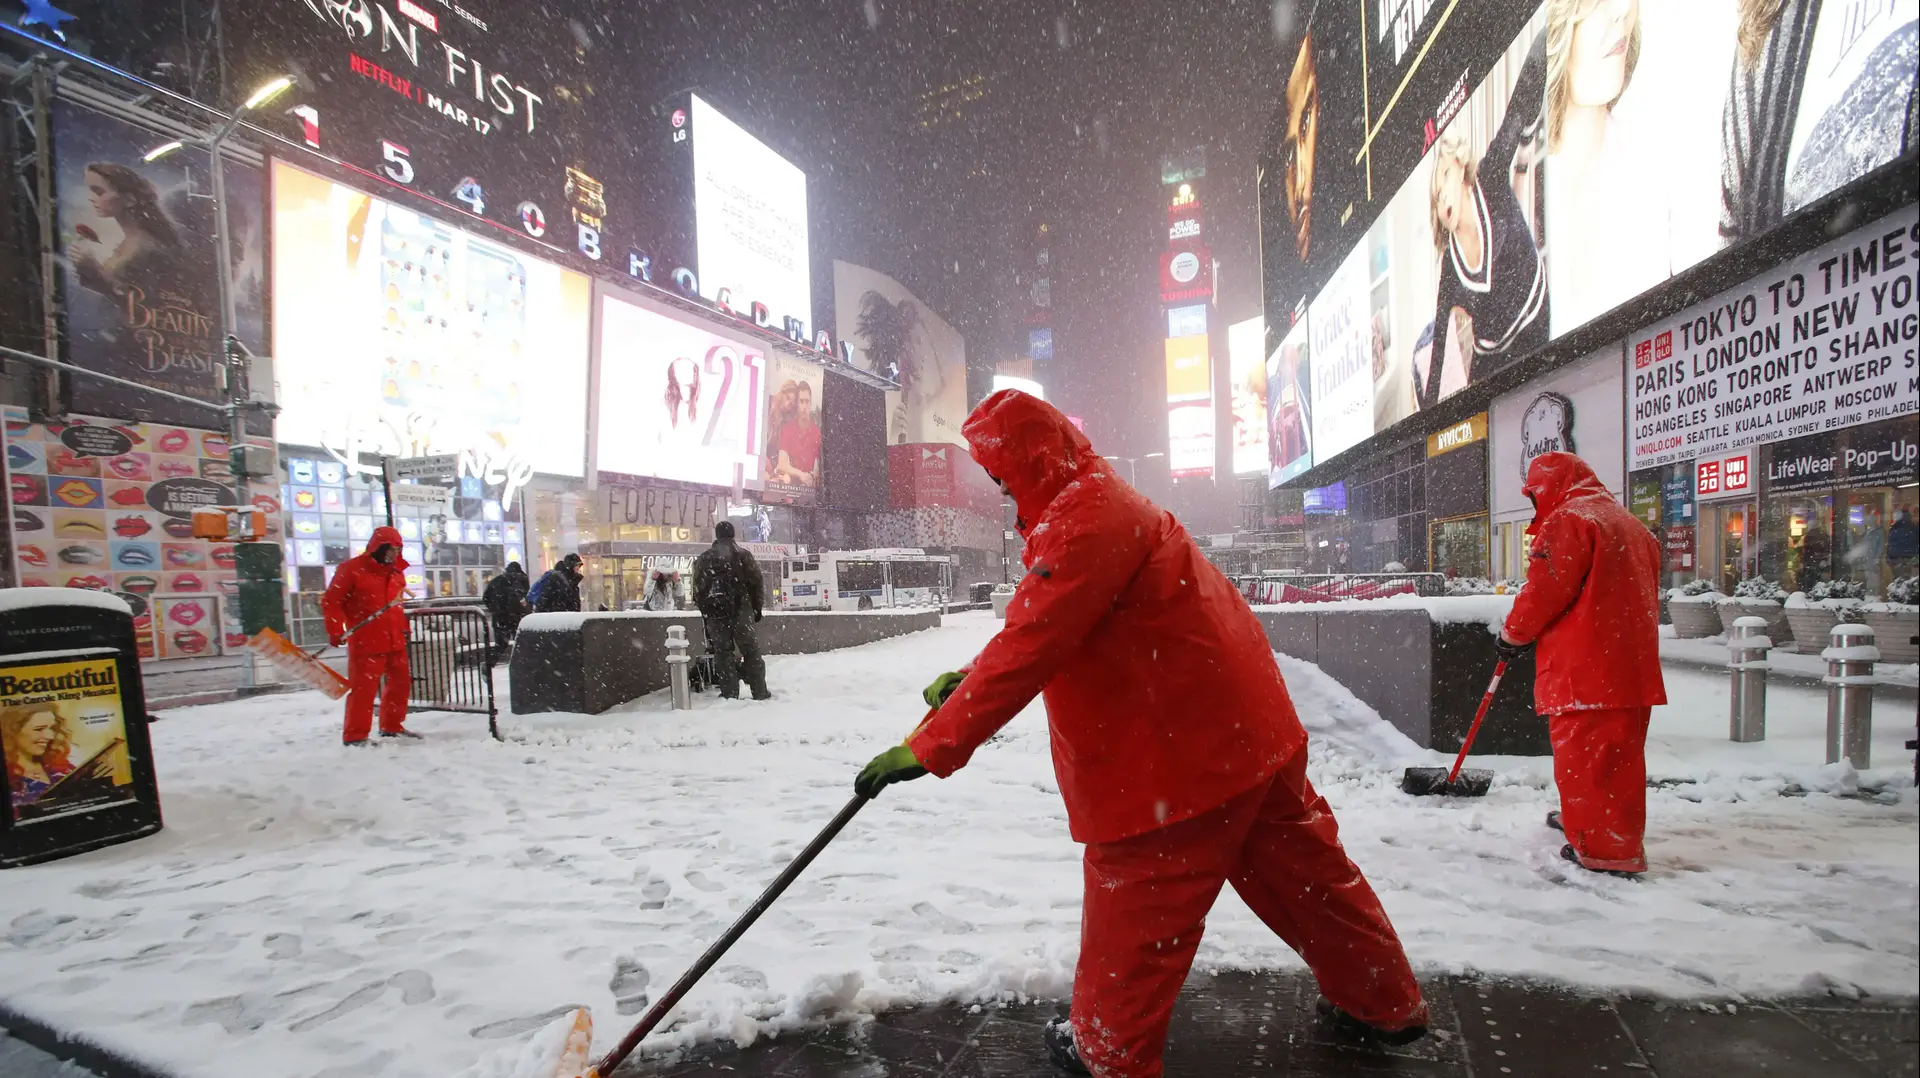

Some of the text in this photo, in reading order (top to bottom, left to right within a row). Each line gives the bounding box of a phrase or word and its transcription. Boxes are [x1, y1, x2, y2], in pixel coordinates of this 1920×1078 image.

[454, 4, 488, 32] SERIES
[350, 52, 490, 135] NETFLIX MAR 17
[440, 41, 543, 133] FIST
[1436, 66, 1470, 119] MARRIOTT
[1437, 89, 1467, 132] MARQUIS
[673, 129, 686, 142] LG
[1170, 223, 1200, 236] POWER
[1161, 287, 1212, 301] TOSHIBA
[1315, 296, 1352, 357] Grace
[1680, 295, 1756, 351] TOKYO
[1768, 273, 1805, 315] TO
[1636, 269, 1919, 398] PARIS LONDON NEW YO
[1656, 334, 1670, 349] UNI
[1317, 330, 1368, 402] Frankie
[1636, 313, 1918, 421] HONG KONG TORONTO SHANG
[1636, 426, 1654, 440] LOS
[1655, 408, 1707, 435] ANGELES
[1715, 384, 1792, 420] SINGAPORE
[1803, 356, 1892, 396] ANTWERP
[1636, 436, 1682, 457] UNIQLO.COM
[1687, 424, 1729, 444] SEATTLE
[1735, 413, 1773, 433] KUALA
[1777, 400, 1826, 424] LUMPUR
[1835, 381, 1898, 410] MOSCOW
[1437, 421, 1473, 451] INVICTA
[1636, 458, 1655, 468] DENVER
[1657, 454, 1676, 465] BERLIN
[1678, 449, 1696, 460] TAIPEI
[1699, 443, 1728, 455] JAKARTA
[1732, 437, 1755, 448] SANTA
[1755, 429, 1783, 444] MONICA
[1788, 421, 1820, 436] SYDNEY
[1825, 412, 1862, 428] BEIJING
[1700, 465, 1718, 478] ユニ
[1726, 460, 1745, 474] UNI
[1768, 439, 1918, 480] LifeWear Pop-Up
[1700, 478, 1718, 491] クロ
[1726, 474, 1746, 488] QLO
[163, 502, 171, 512] A
[168, 492, 217, 504] IS GETTING
[609, 486, 717, 529] FOREVER
[753, 544, 771, 554] POLO
[7, 624, 93, 637] SOLAR COMPACTOR
[0, 665, 115, 697] Beautiful
[2, 685, 117, 708] The Carole King Musical
